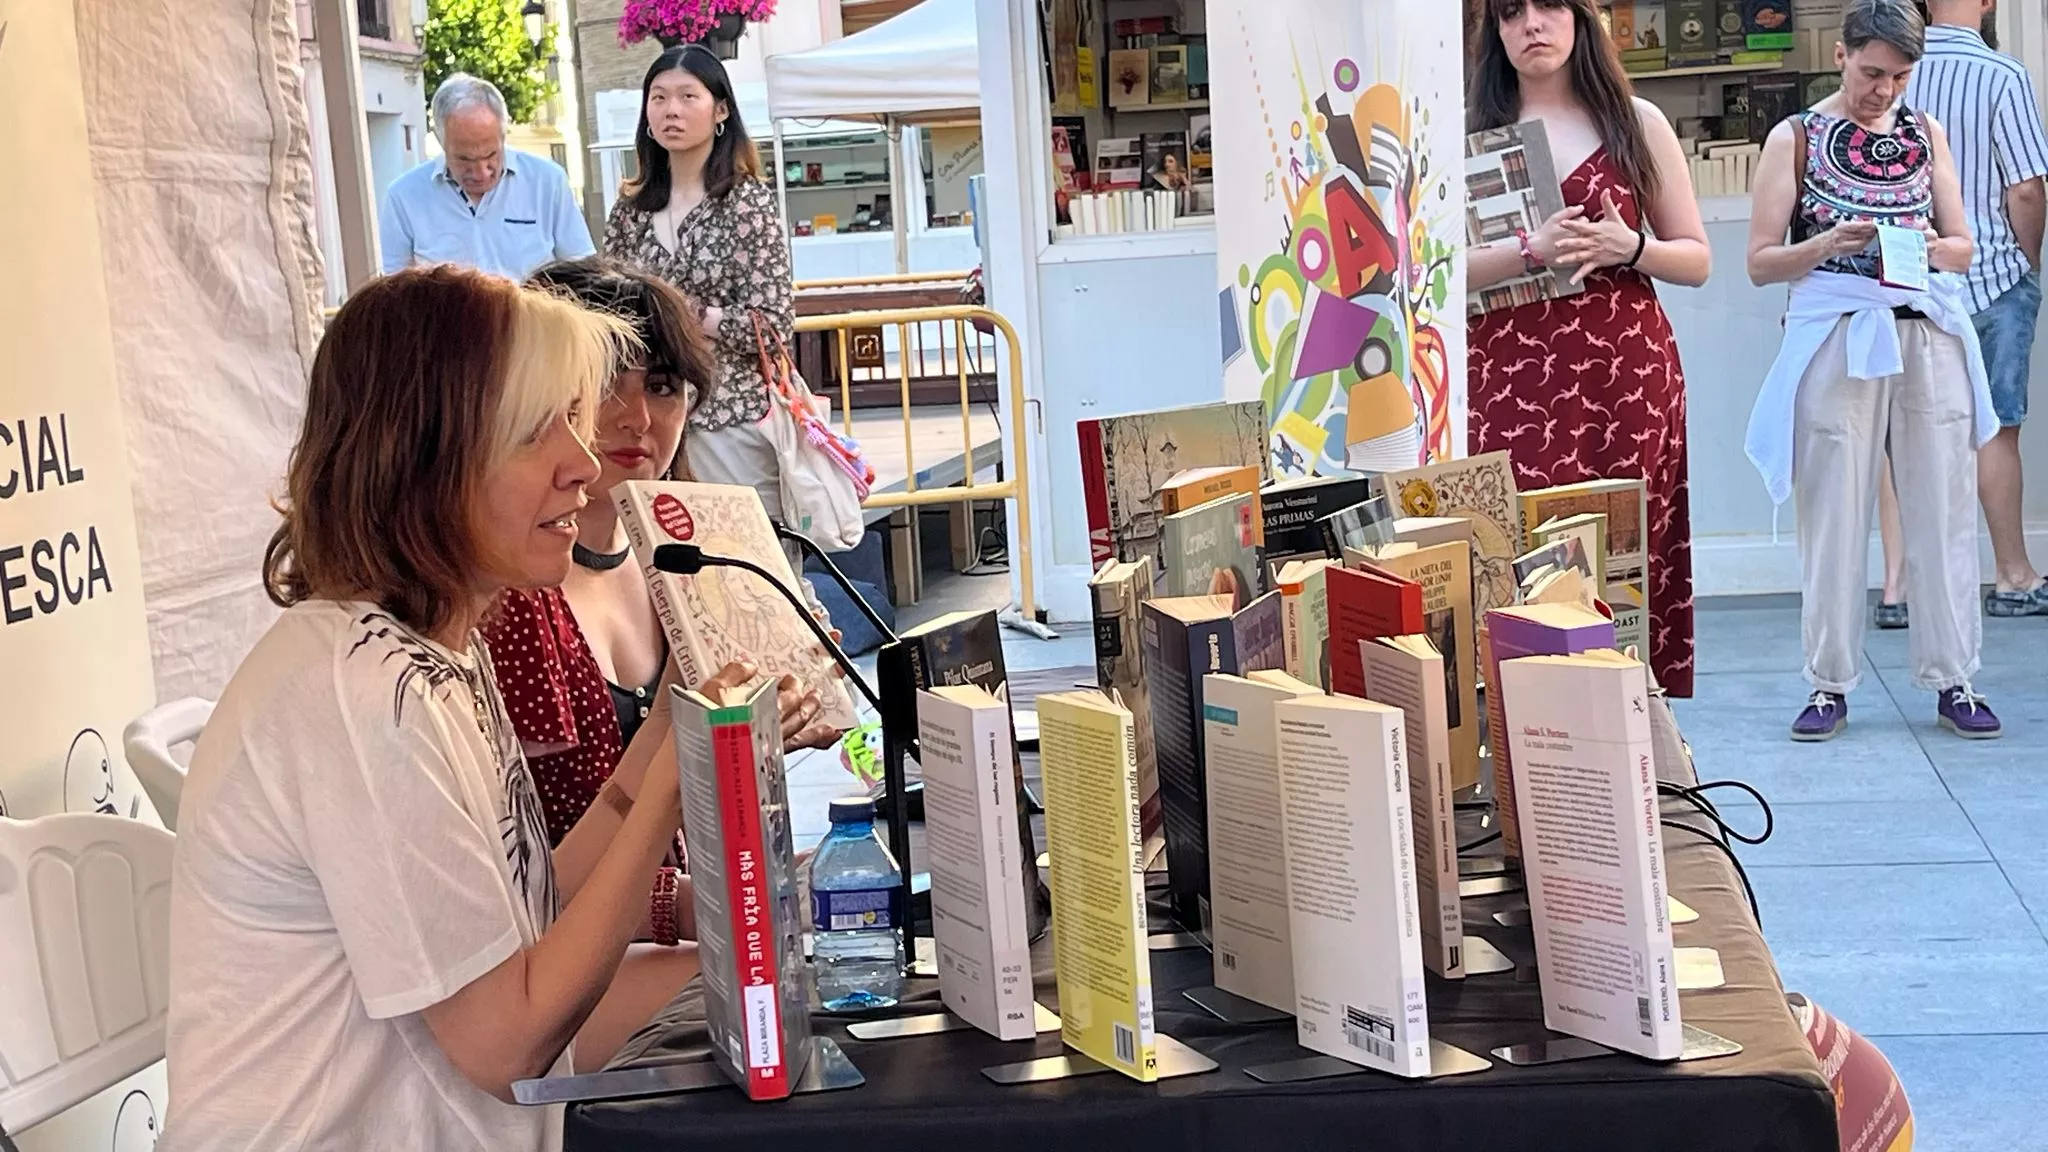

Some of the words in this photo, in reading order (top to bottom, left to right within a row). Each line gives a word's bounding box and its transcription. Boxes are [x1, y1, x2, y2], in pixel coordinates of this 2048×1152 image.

[1279, 510, 1315, 525] PRIMAS
[1520, 510, 1529, 547] COAST
[0, 526, 112, 624] ESCA
[650, 579, 675, 627] Cuerpo
[670, 626, 683, 645] de
[678, 646, 698, 686] Cristo
[1613, 615, 1639, 628] OAST
[1125, 725, 1137, 766] común
[1391, 727, 1400, 760] Victoria
[1127, 769, 1139, 800] nada
[1640, 754, 1649, 784] Alana
[1130, 802, 1143, 846] lectora
[1644, 798, 1654, 837] Portero
[1650, 856, 1660, 879] mala
[742, 886, 760, 925] FRÍA
[1652, 882, 1665, 934] costumbre
[746, 928, 764, 962] QUE
